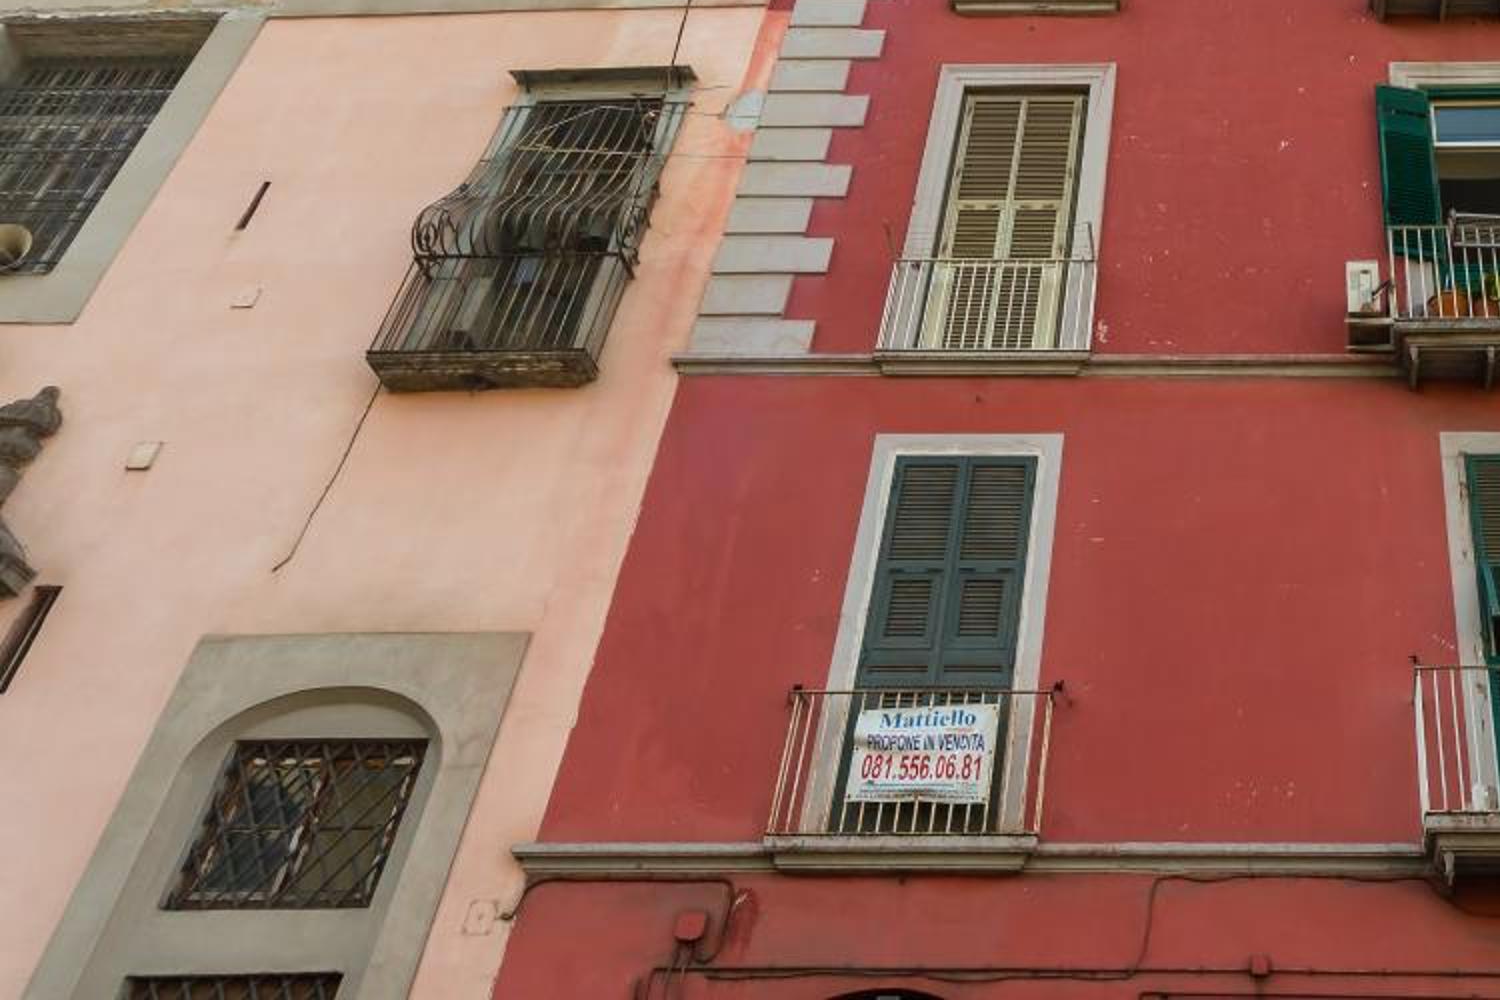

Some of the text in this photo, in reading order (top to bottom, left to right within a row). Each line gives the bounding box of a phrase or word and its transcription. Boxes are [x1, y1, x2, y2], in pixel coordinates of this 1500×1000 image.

[880, 709, 976, 728] Mattiello
[867, 733, 985, 751] PROPONE IN VENDITA
[861, 754, 982, 780] 081.556.06.81
